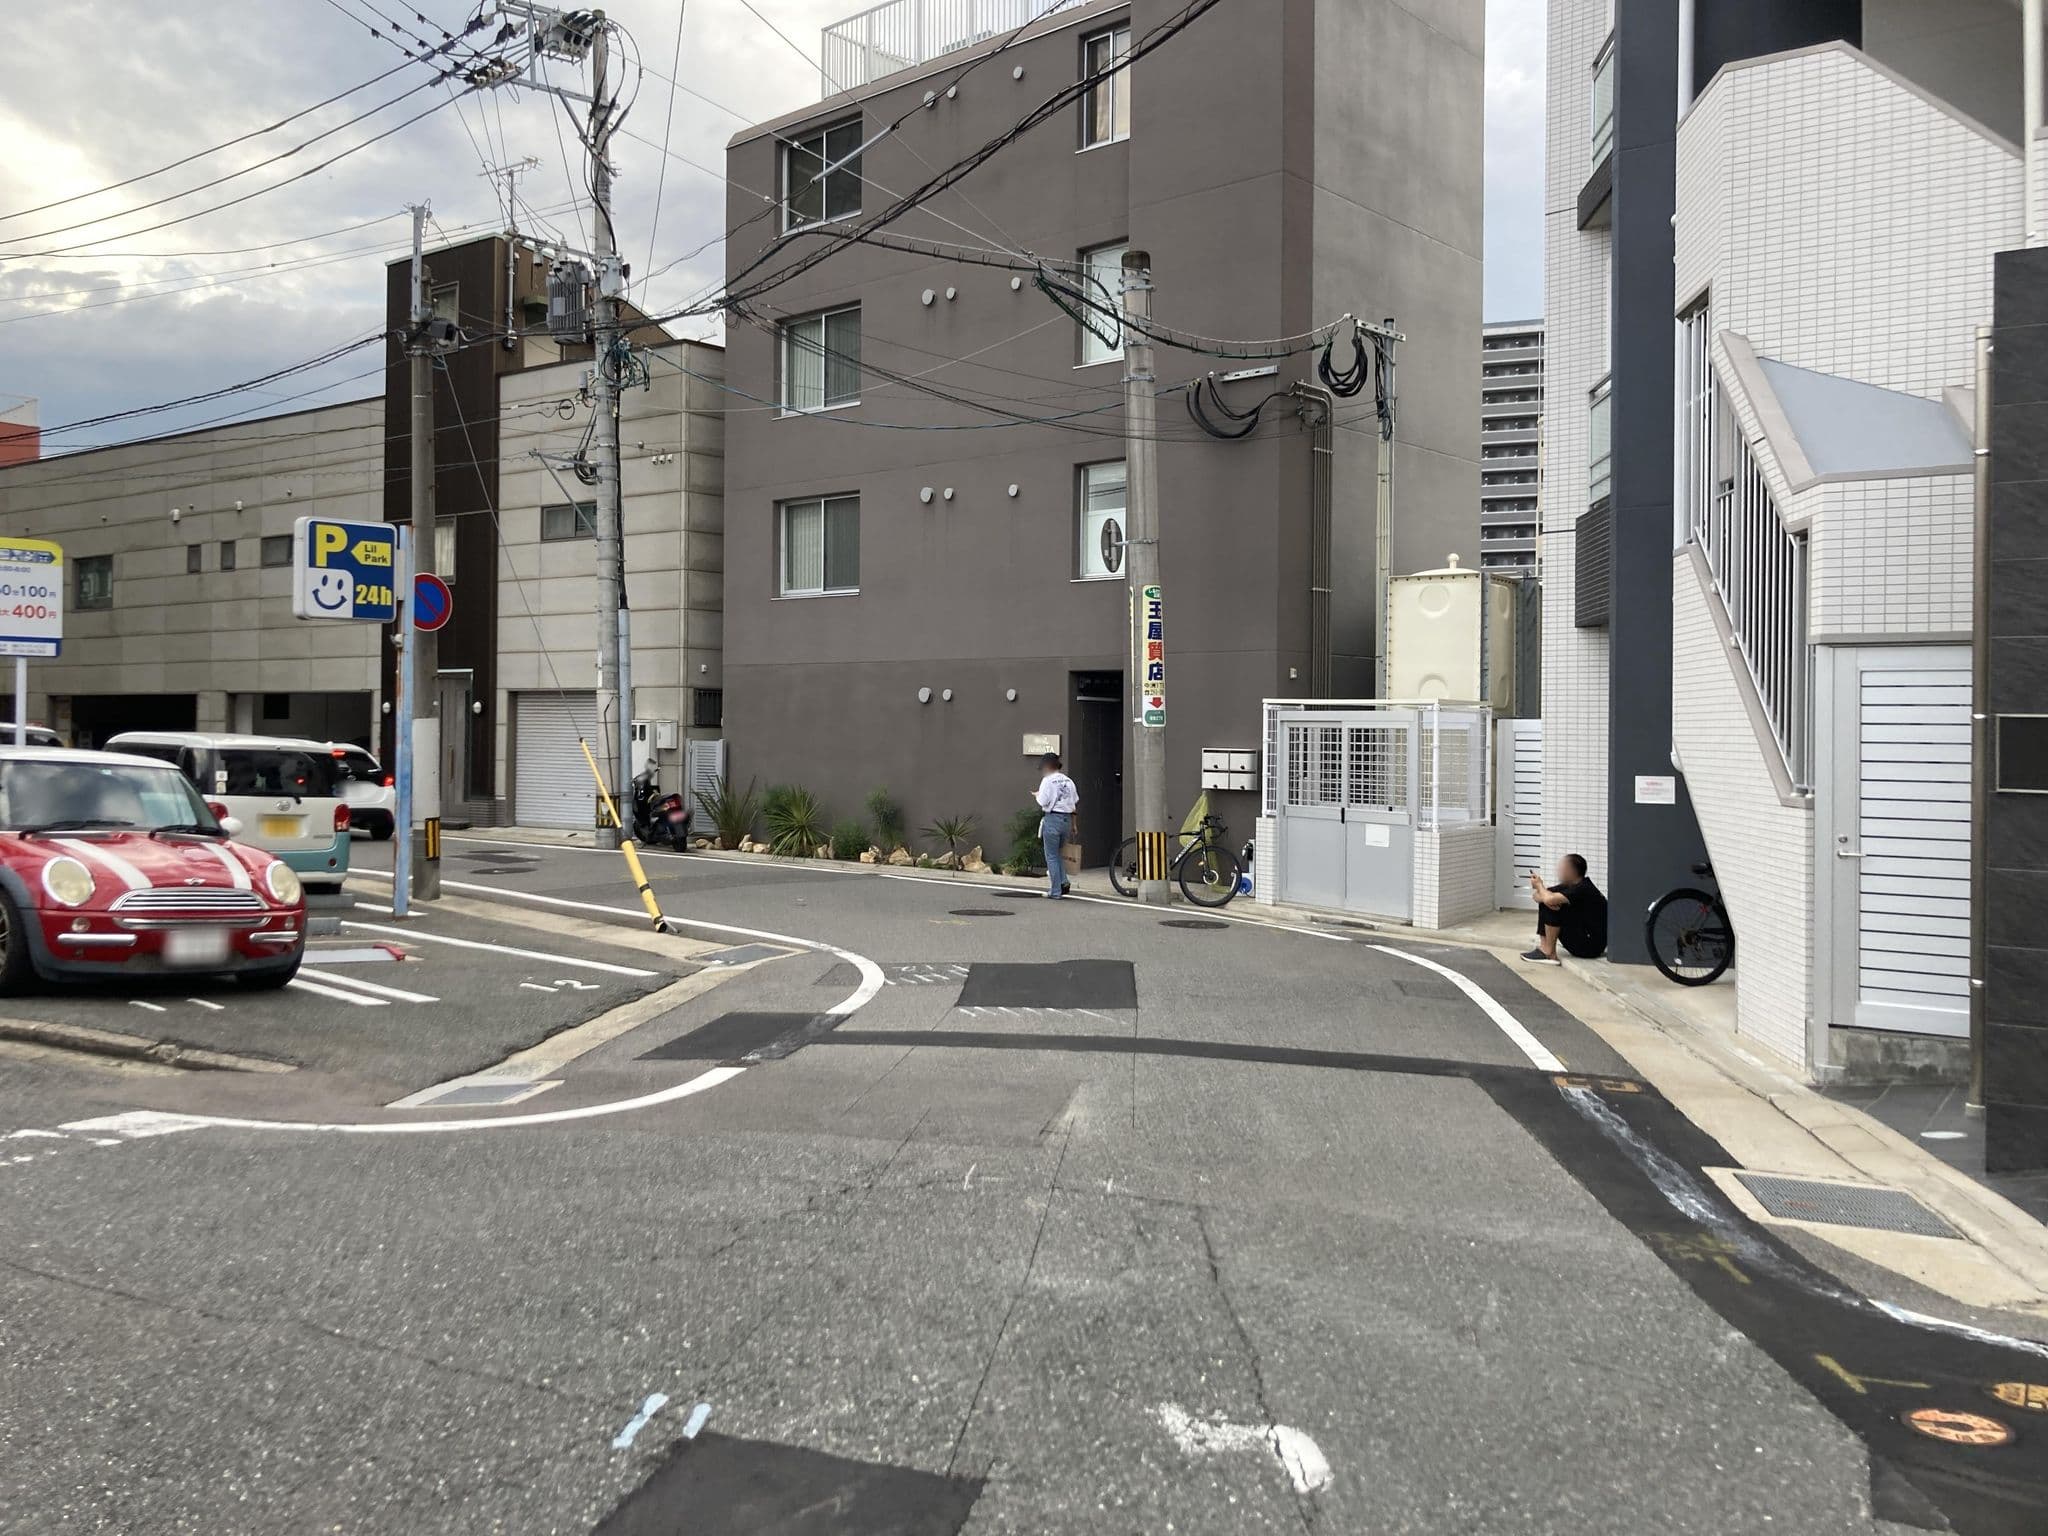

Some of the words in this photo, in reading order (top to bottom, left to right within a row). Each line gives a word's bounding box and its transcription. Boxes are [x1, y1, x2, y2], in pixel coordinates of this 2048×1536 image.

[315, 523, 348, 568] P
[364, 544, 377, 553] Lil
[364, 554, 388, 564] Park
[355, 584, 393, 606] 24h
[1147, 601, 1164, 681] 玉屋質店
